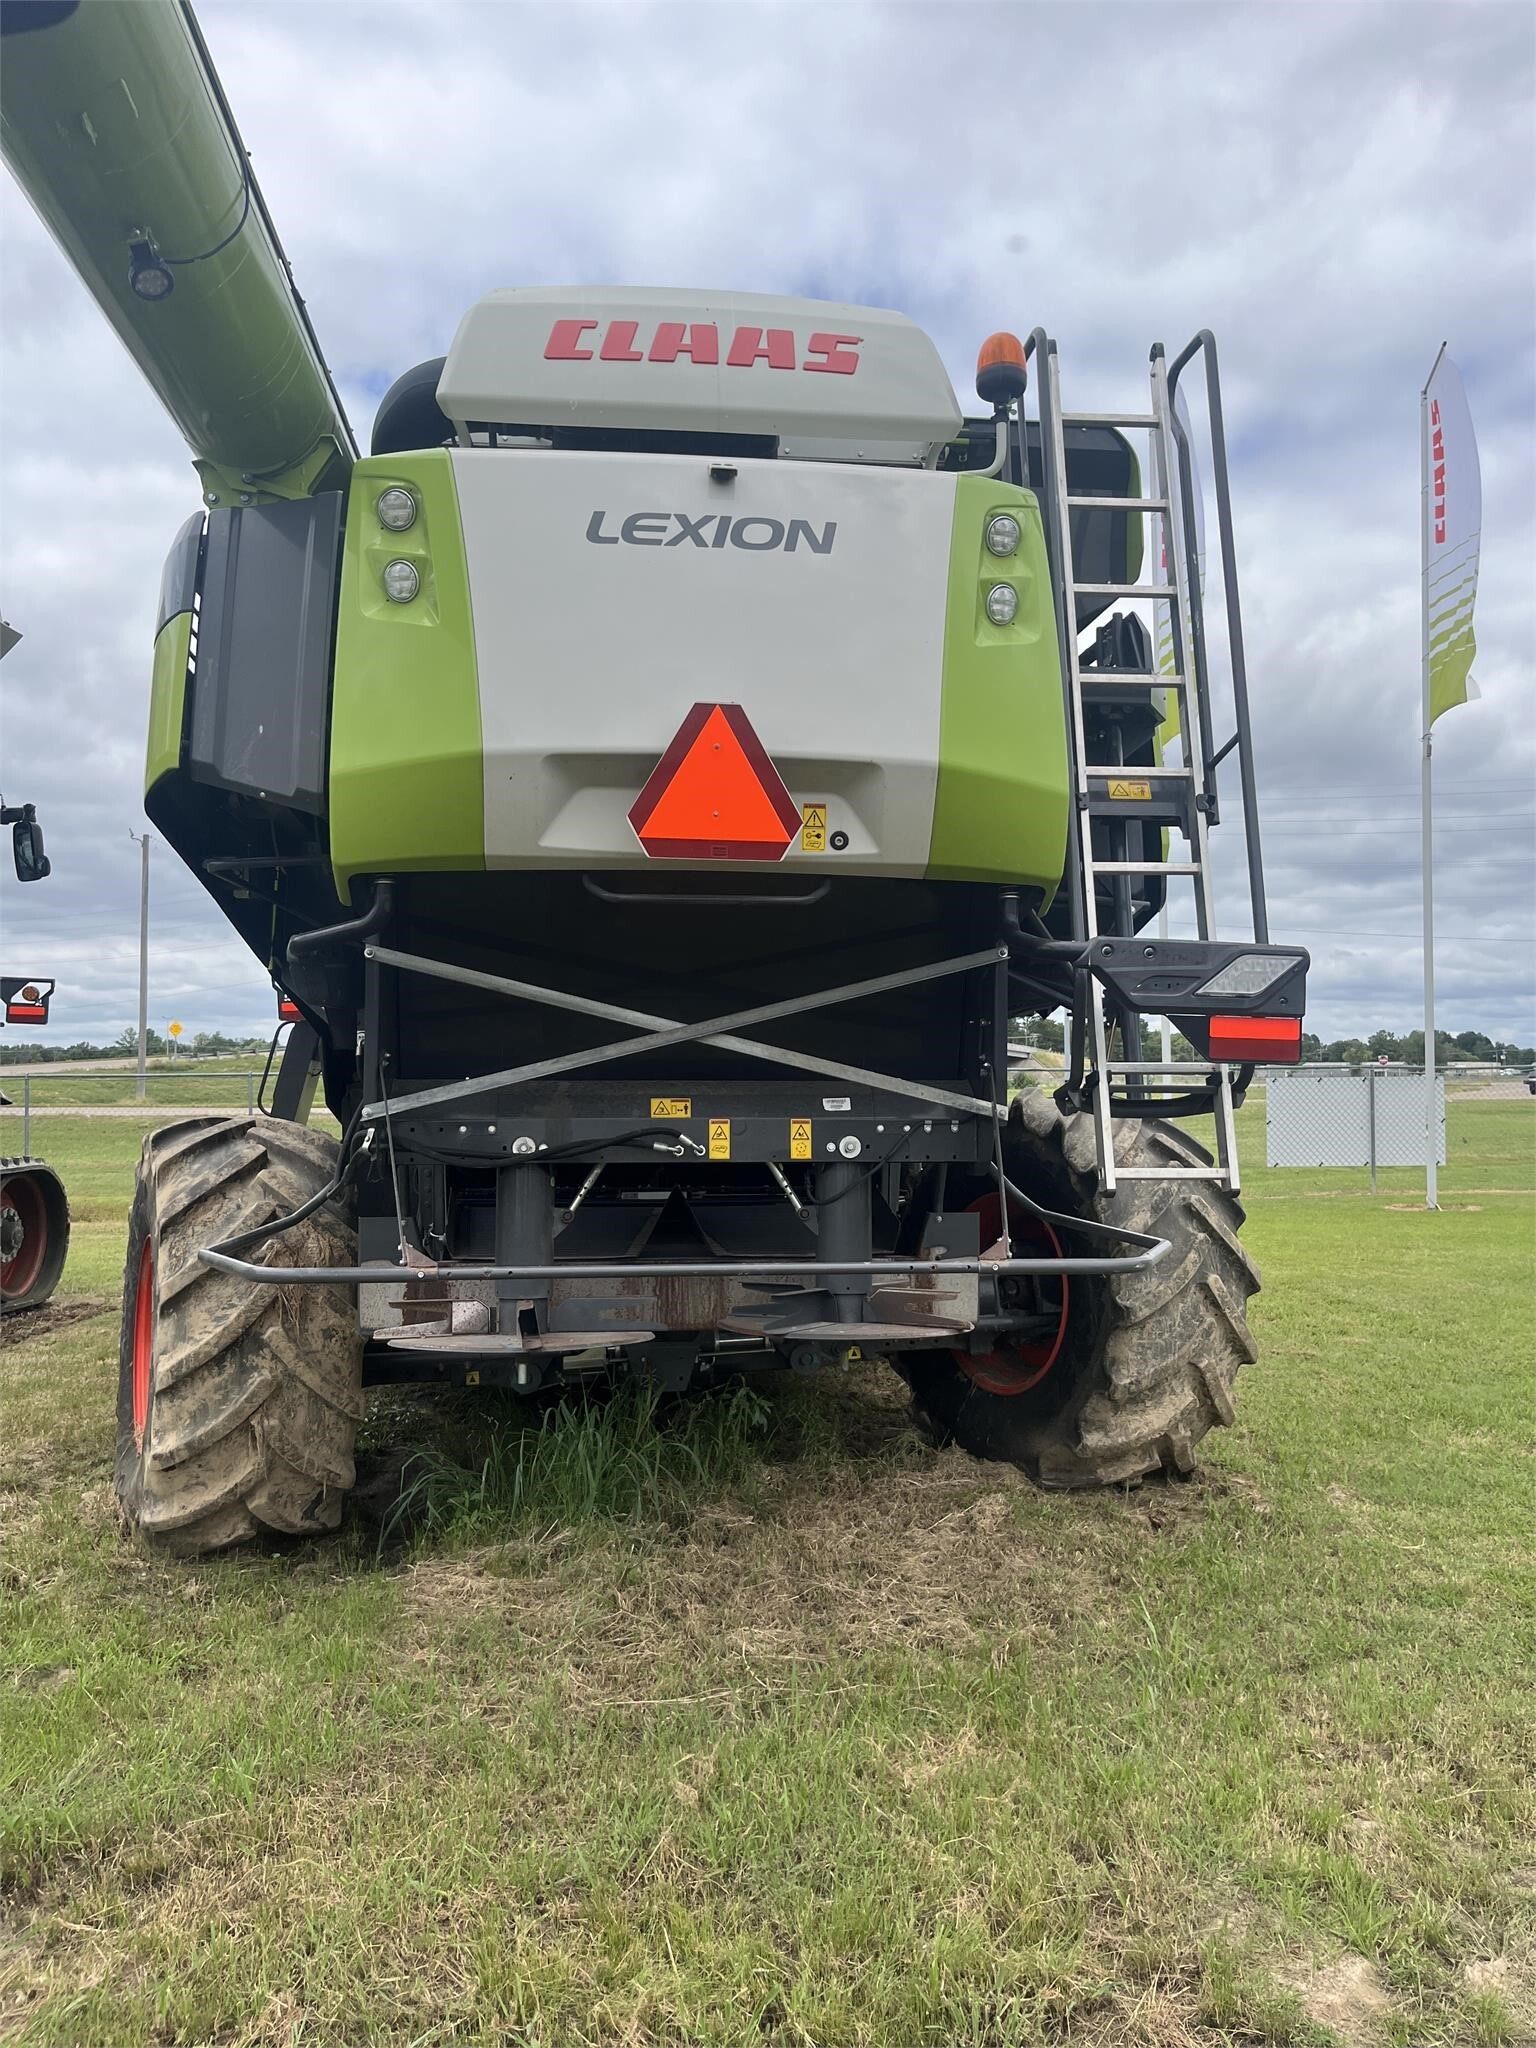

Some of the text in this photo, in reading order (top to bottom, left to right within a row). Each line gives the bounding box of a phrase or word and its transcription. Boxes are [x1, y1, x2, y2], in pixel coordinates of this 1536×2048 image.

[544, 319, 860, 375] CLAAS
[1431, 399, 1446, 544] CLAAS
[585, 511, 838, 554] LEXION
